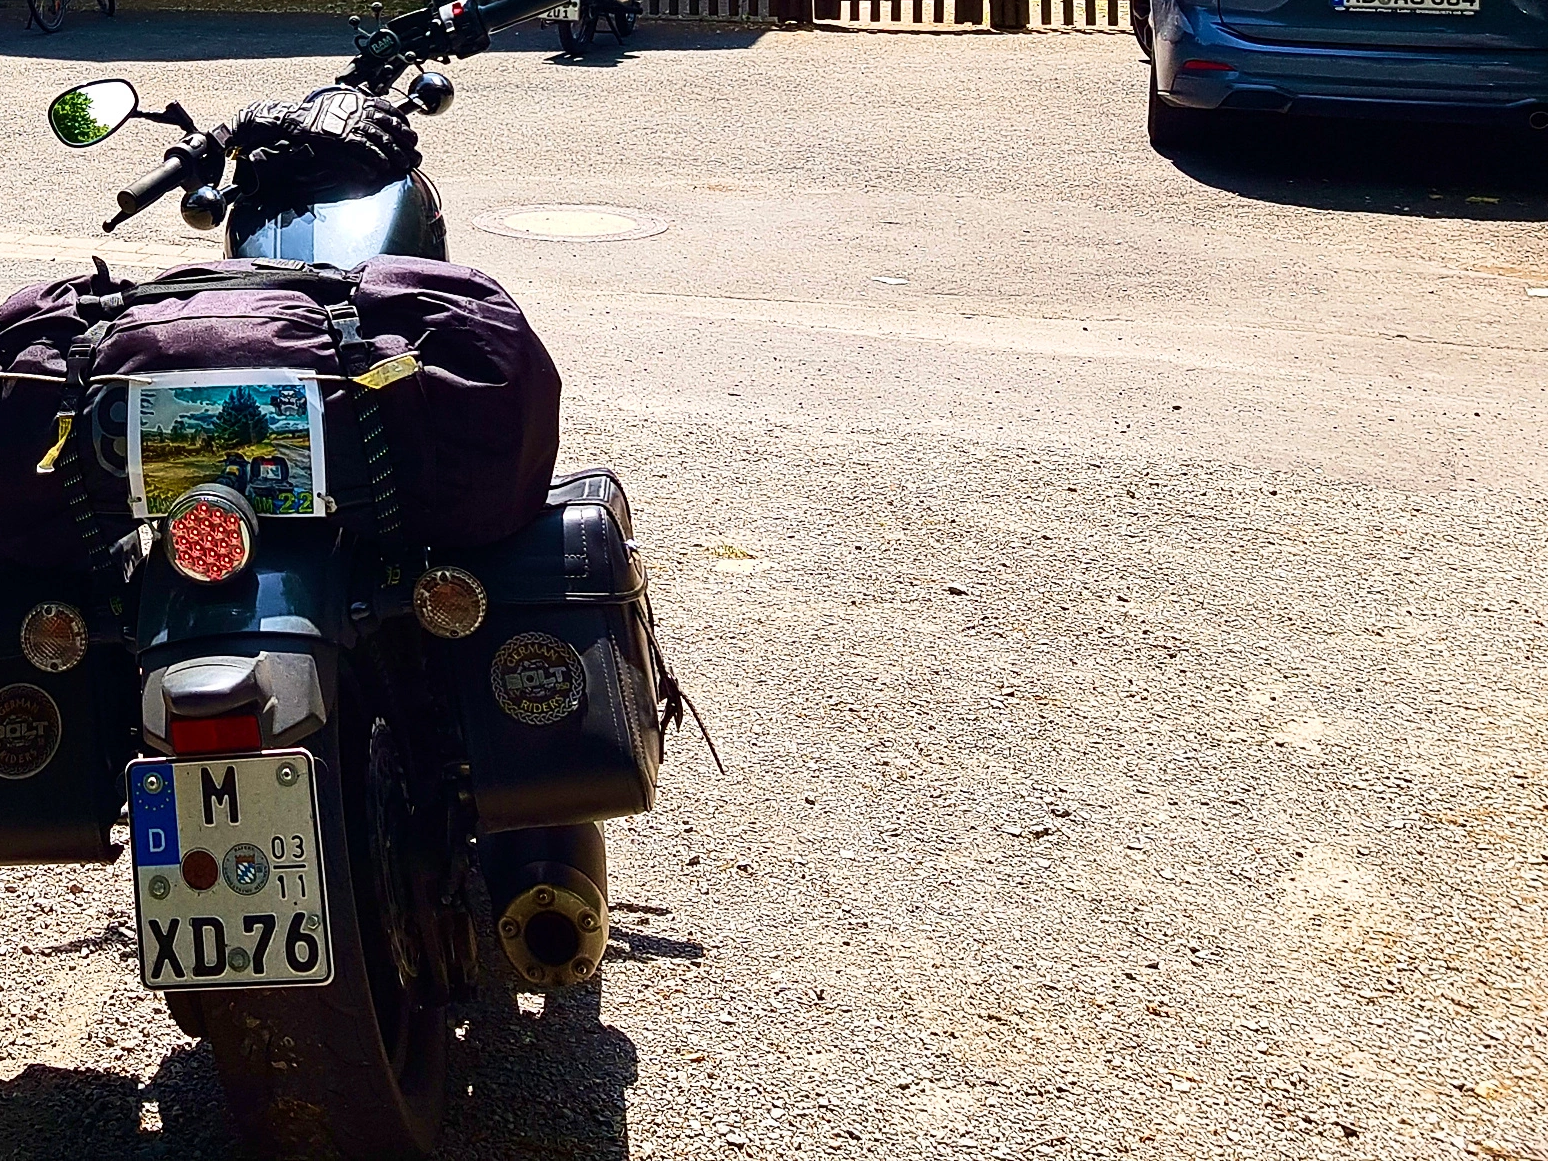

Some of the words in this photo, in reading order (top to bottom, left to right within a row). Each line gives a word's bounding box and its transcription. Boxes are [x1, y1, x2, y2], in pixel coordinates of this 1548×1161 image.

[372, 35, 394, 54] RAM
[279, 492, 313, 514] 22
[506, 643, 558, 667] GERMAN
[505, 666, 567, 690] BOLT
[520, 694, 564, 713] RIDERS
[201, 765, 240, 825] M
[148, 828, 165, 852] D
[272, 835, 305, 859] 03
[277, 874, 306, 898] 11
[148, 916, 227, 980] XD
[243, 911, 319, 975] 76
